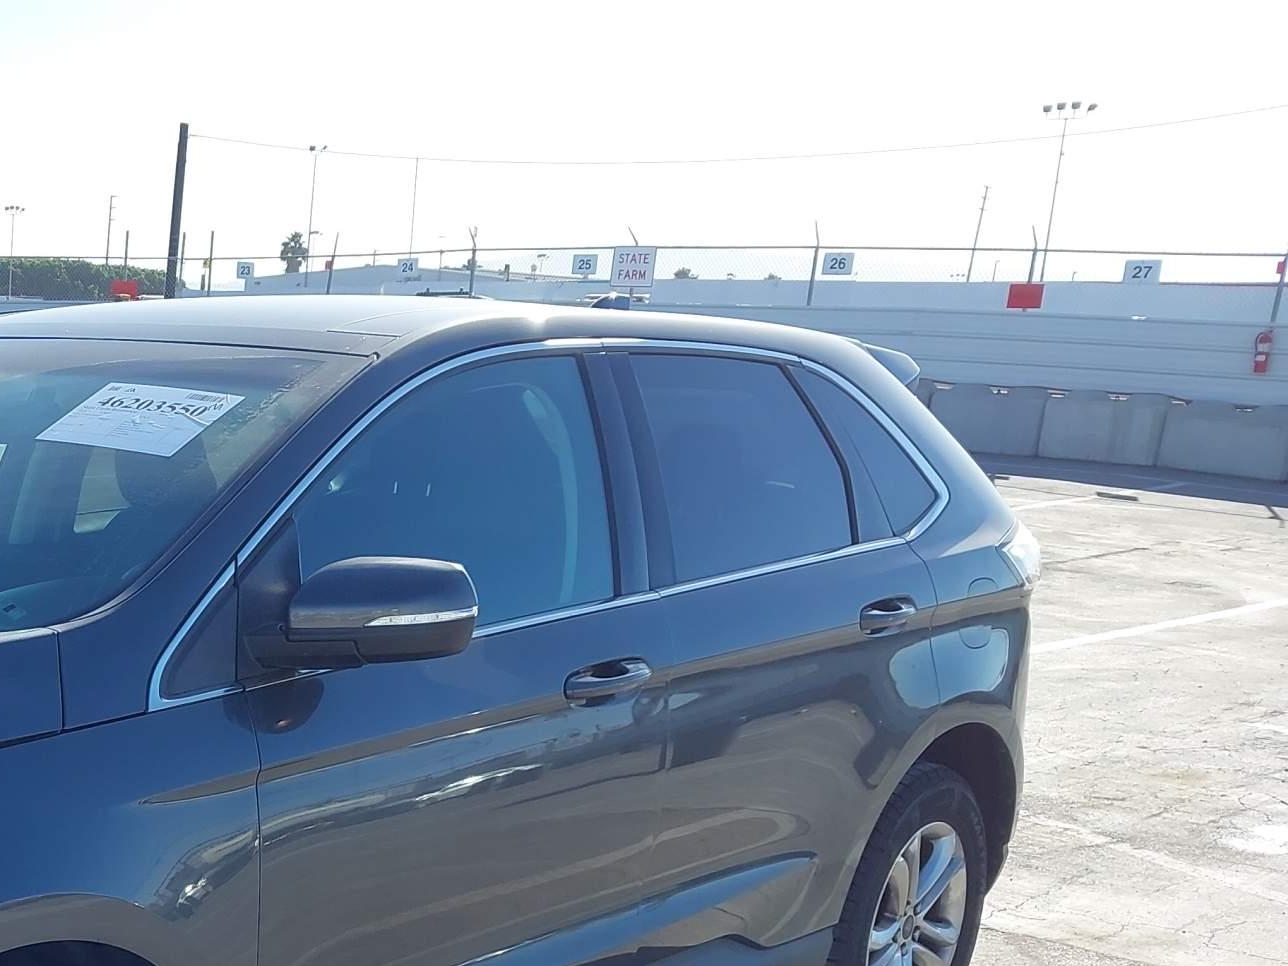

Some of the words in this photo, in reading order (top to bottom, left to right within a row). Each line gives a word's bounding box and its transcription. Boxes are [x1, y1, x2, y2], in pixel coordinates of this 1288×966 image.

[578, 258, 592, 270] 25
[618, 252, 650, 265] STATE
[829, 257, 847, 270] 26
[240, 265, 251, 276] 23
[402, 262, 414, 273] 24
[1131, 265, 1153, 279] 27
[617, 268, 647, 281] FARM
[98, 395, 208, 417] 46203550
